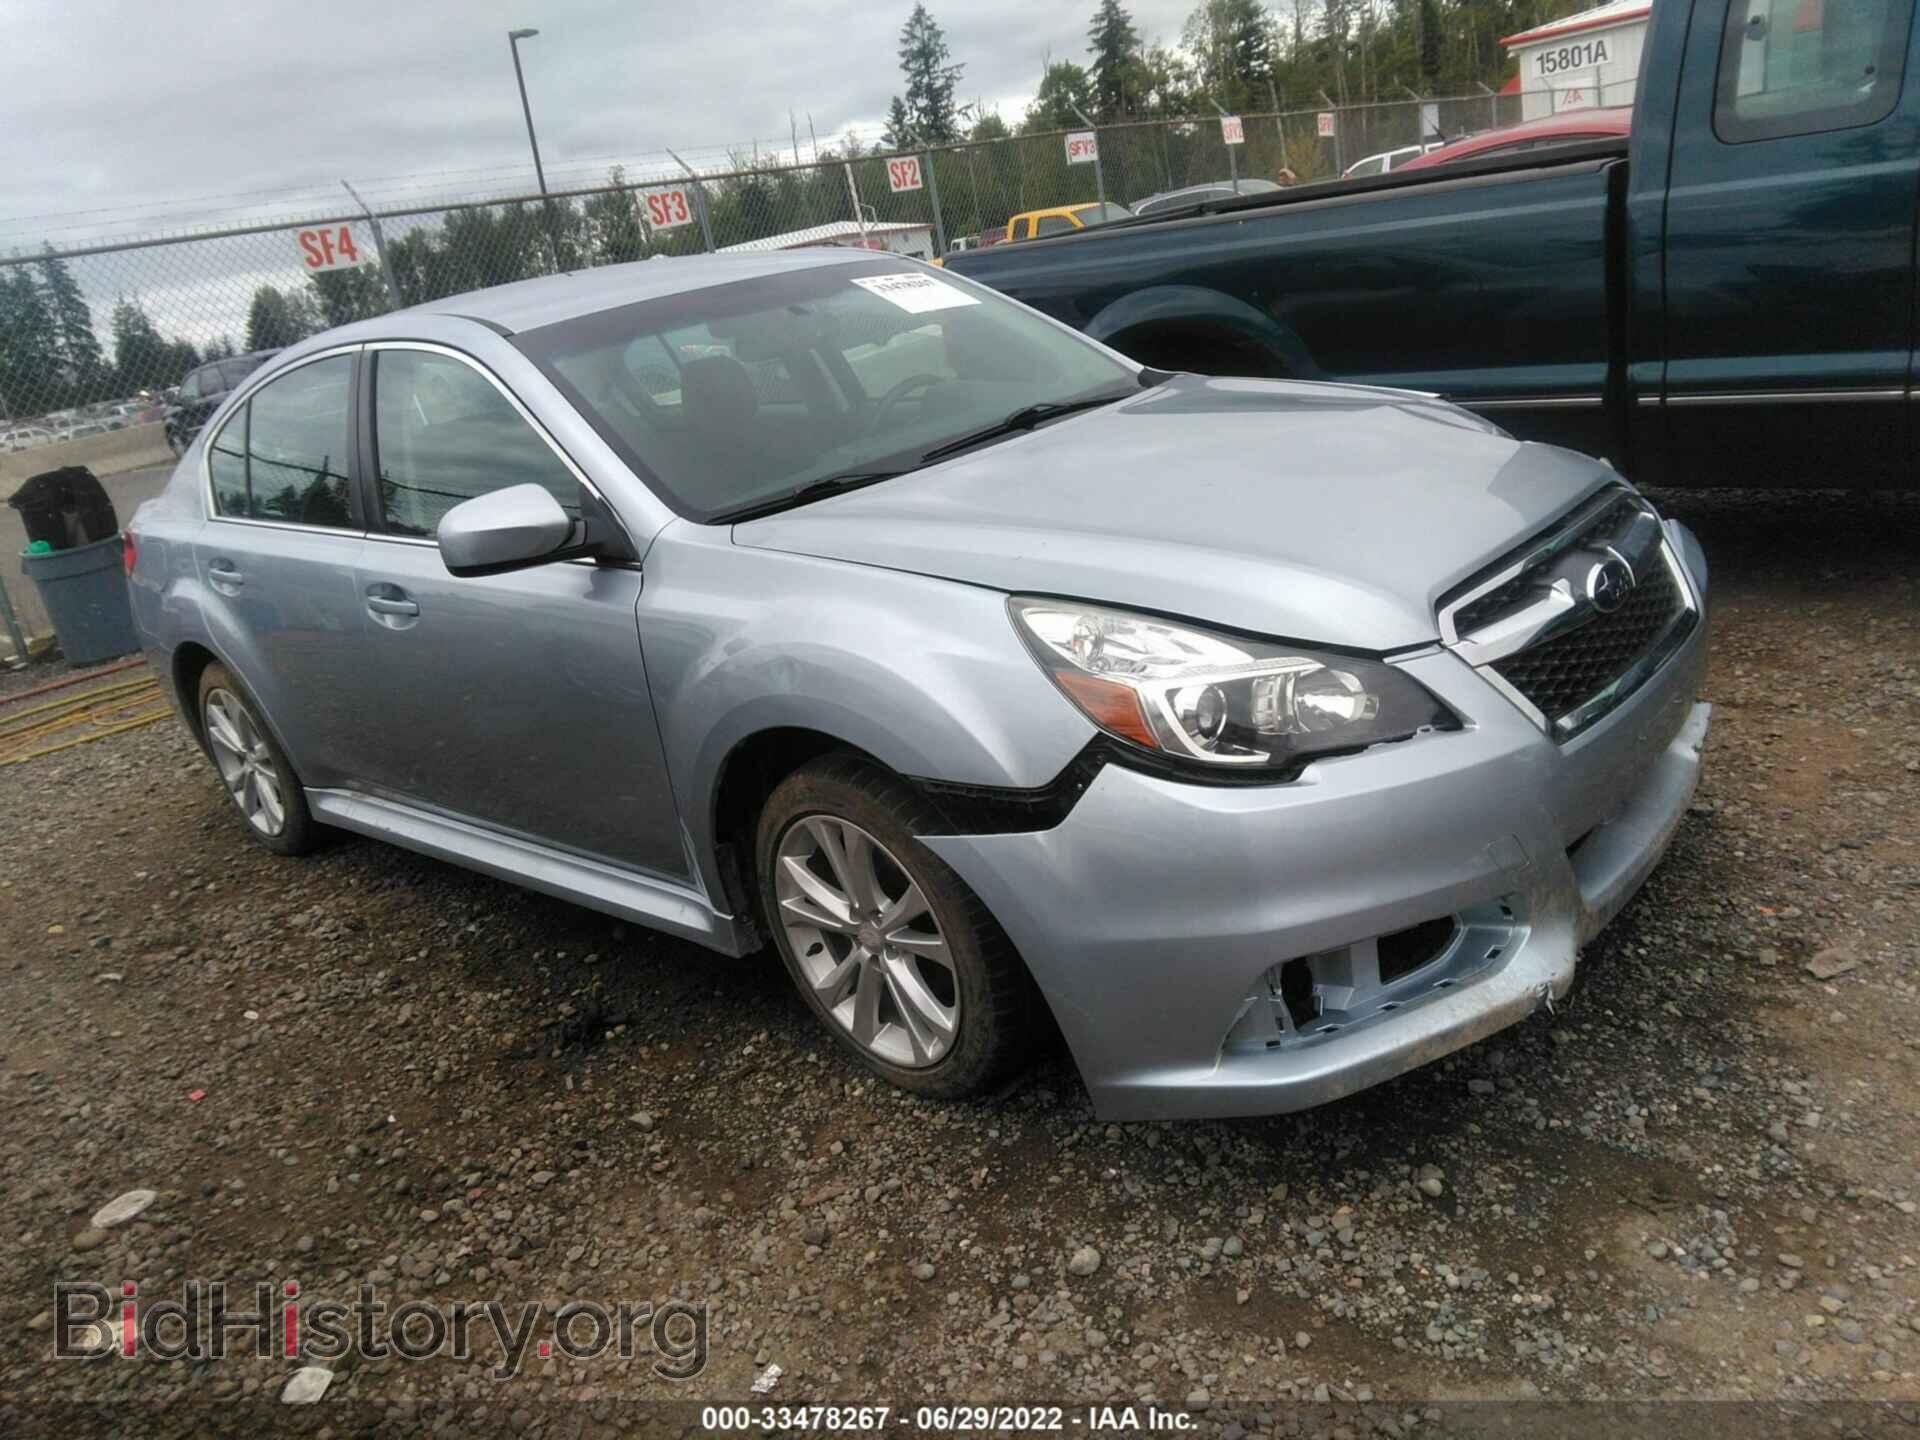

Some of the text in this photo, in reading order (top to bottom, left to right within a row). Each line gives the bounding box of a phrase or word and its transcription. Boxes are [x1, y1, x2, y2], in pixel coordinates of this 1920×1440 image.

[1535, 39, 1609, 75] 15801A
[889, 159, 921, 190] SF2
[646, 189, 689, 226] SF3
[299, 226, 359, 269] SF4
